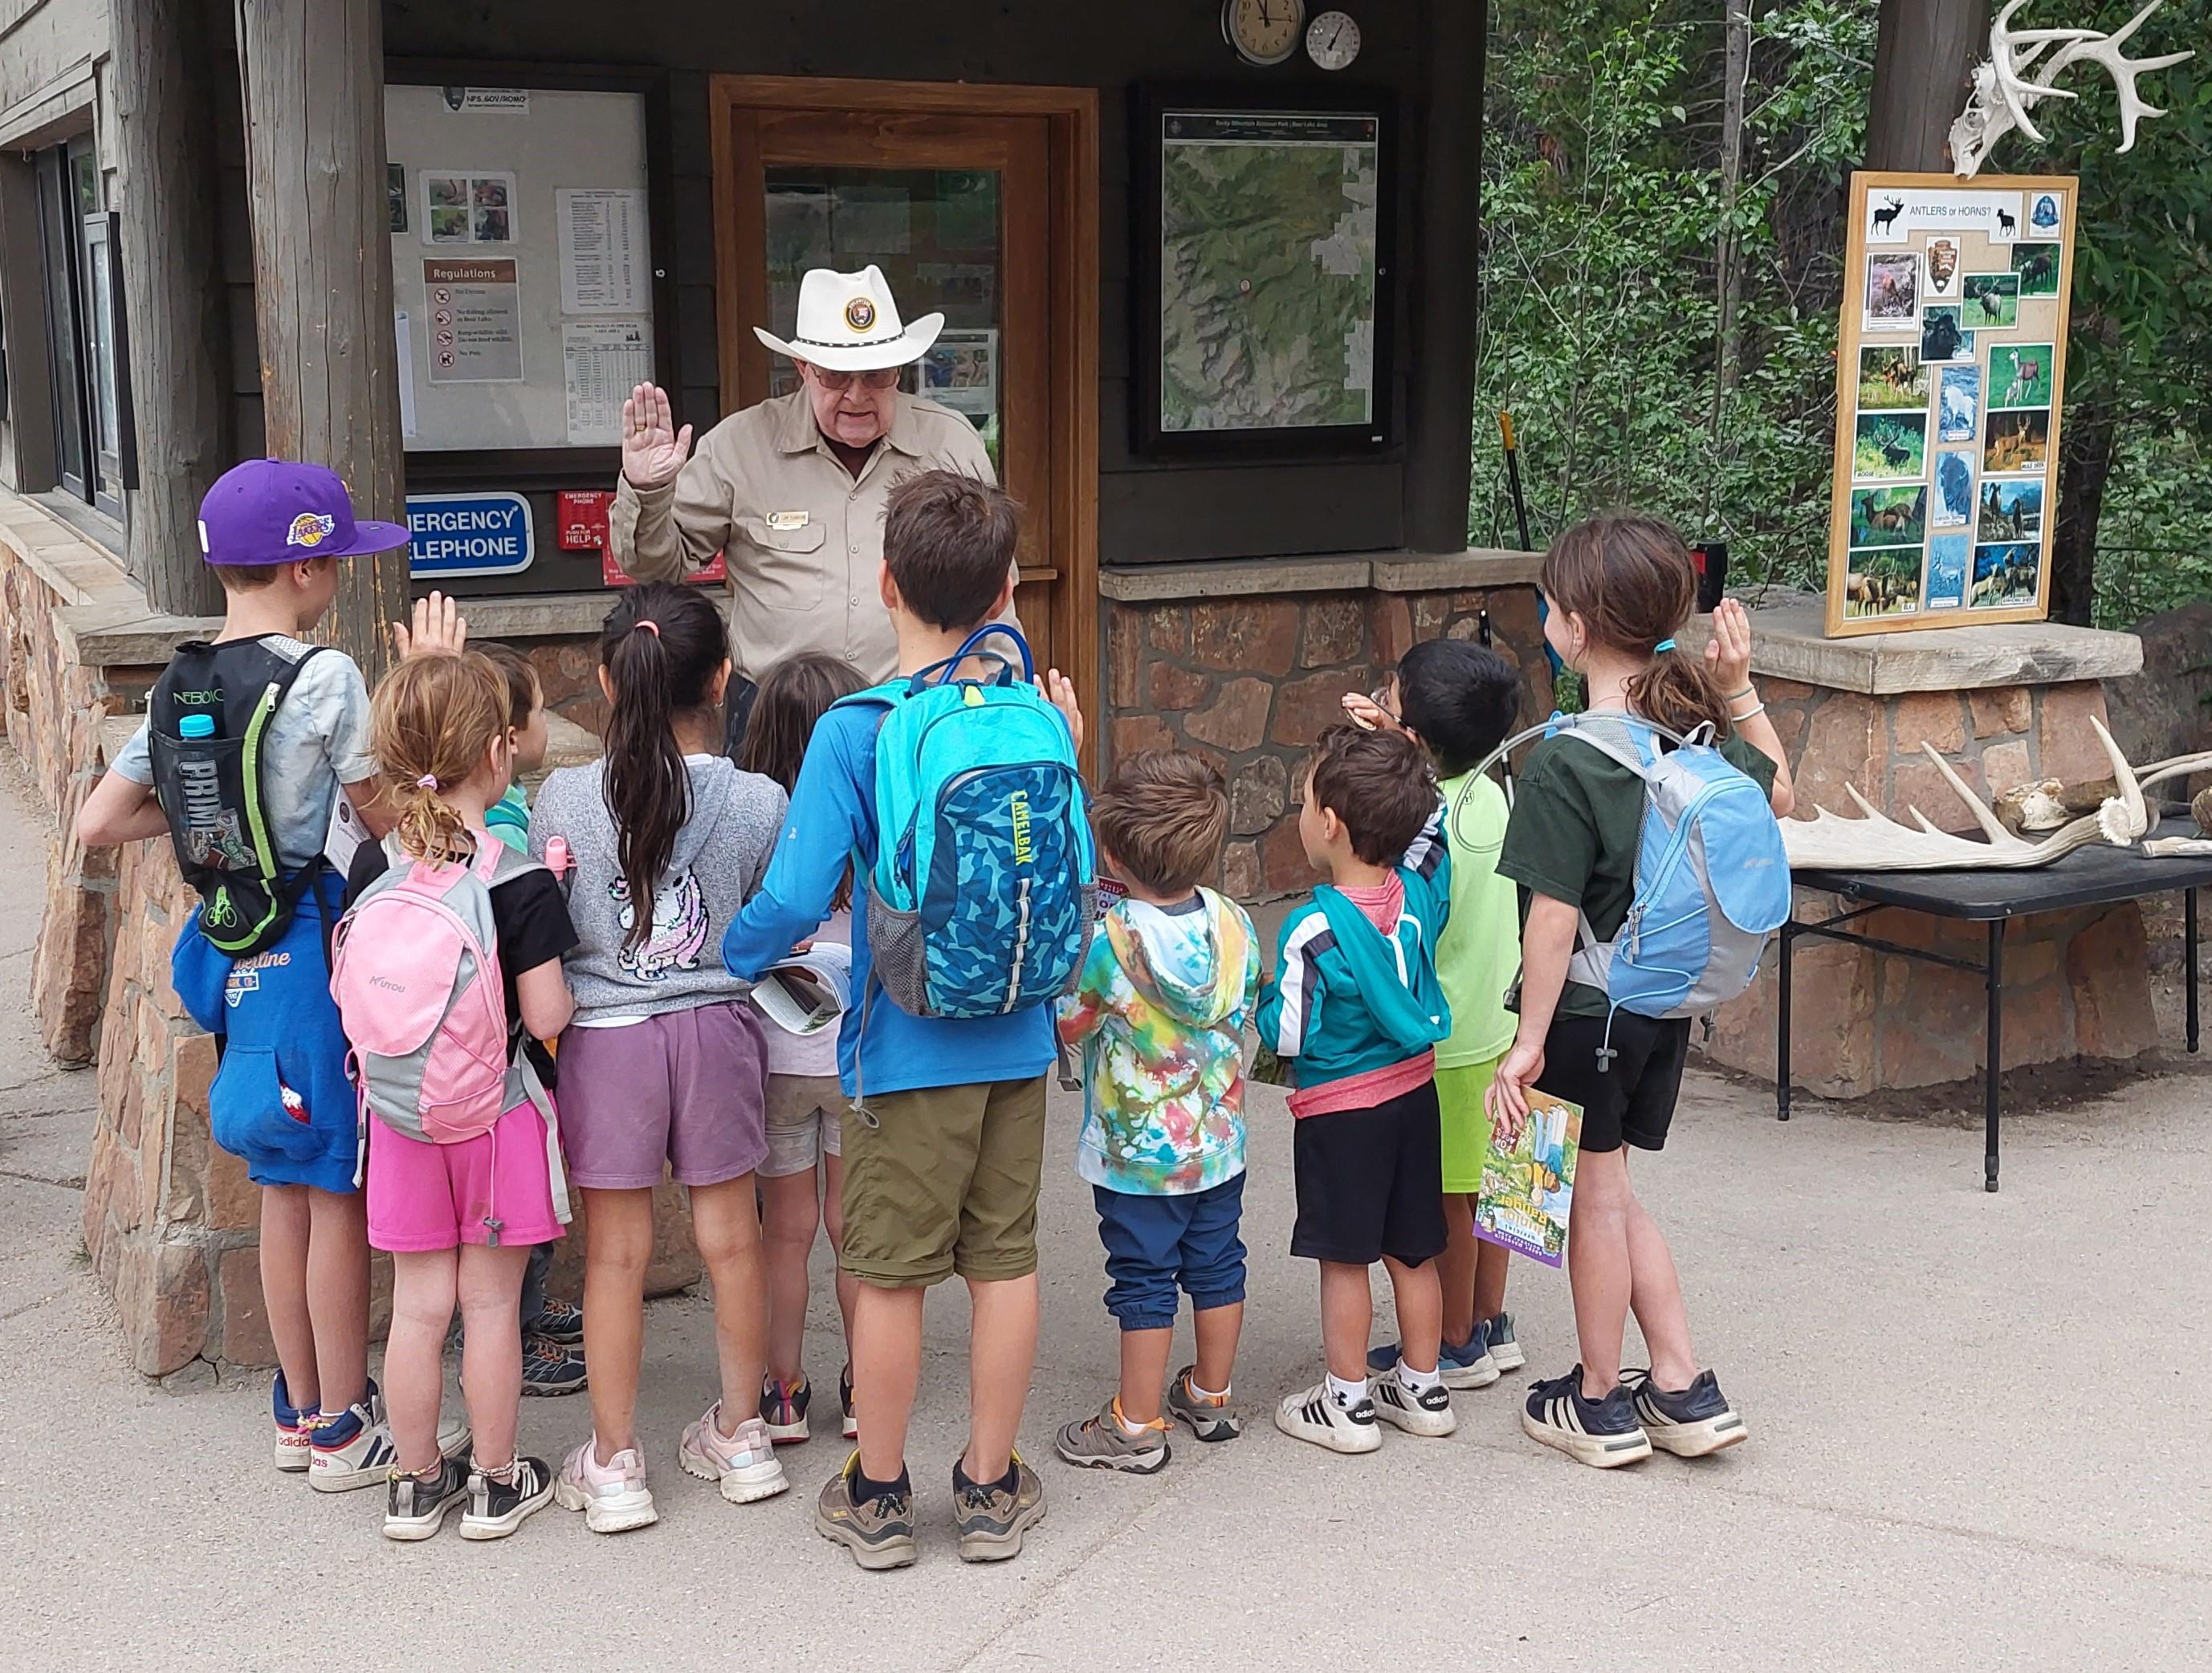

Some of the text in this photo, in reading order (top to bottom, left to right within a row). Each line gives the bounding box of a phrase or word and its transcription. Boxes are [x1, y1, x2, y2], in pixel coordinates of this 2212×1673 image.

[466, 95, 527, 104] NPS.GOV/ROMO
[1910, 206, 1991, 218] ANTLERS or HORNS?
[434, 269, 495, 280] Regulations
[564, 491, 603, 499] EMERGENCY
[406, 510, 514, 532] ERGENCY
[566, 535, 591, 544] HELP
[409, 537, 519, 561] LEPHONE
[178, 759, 220, 832] PRIM
[1011, 789, 1033, 866] CAMELBAK
[1499, 1195, 1547, 1226] Ranger
[1502, 1209, 1542, 1235] Junior
[279, 1436, 312, 1447] adida
